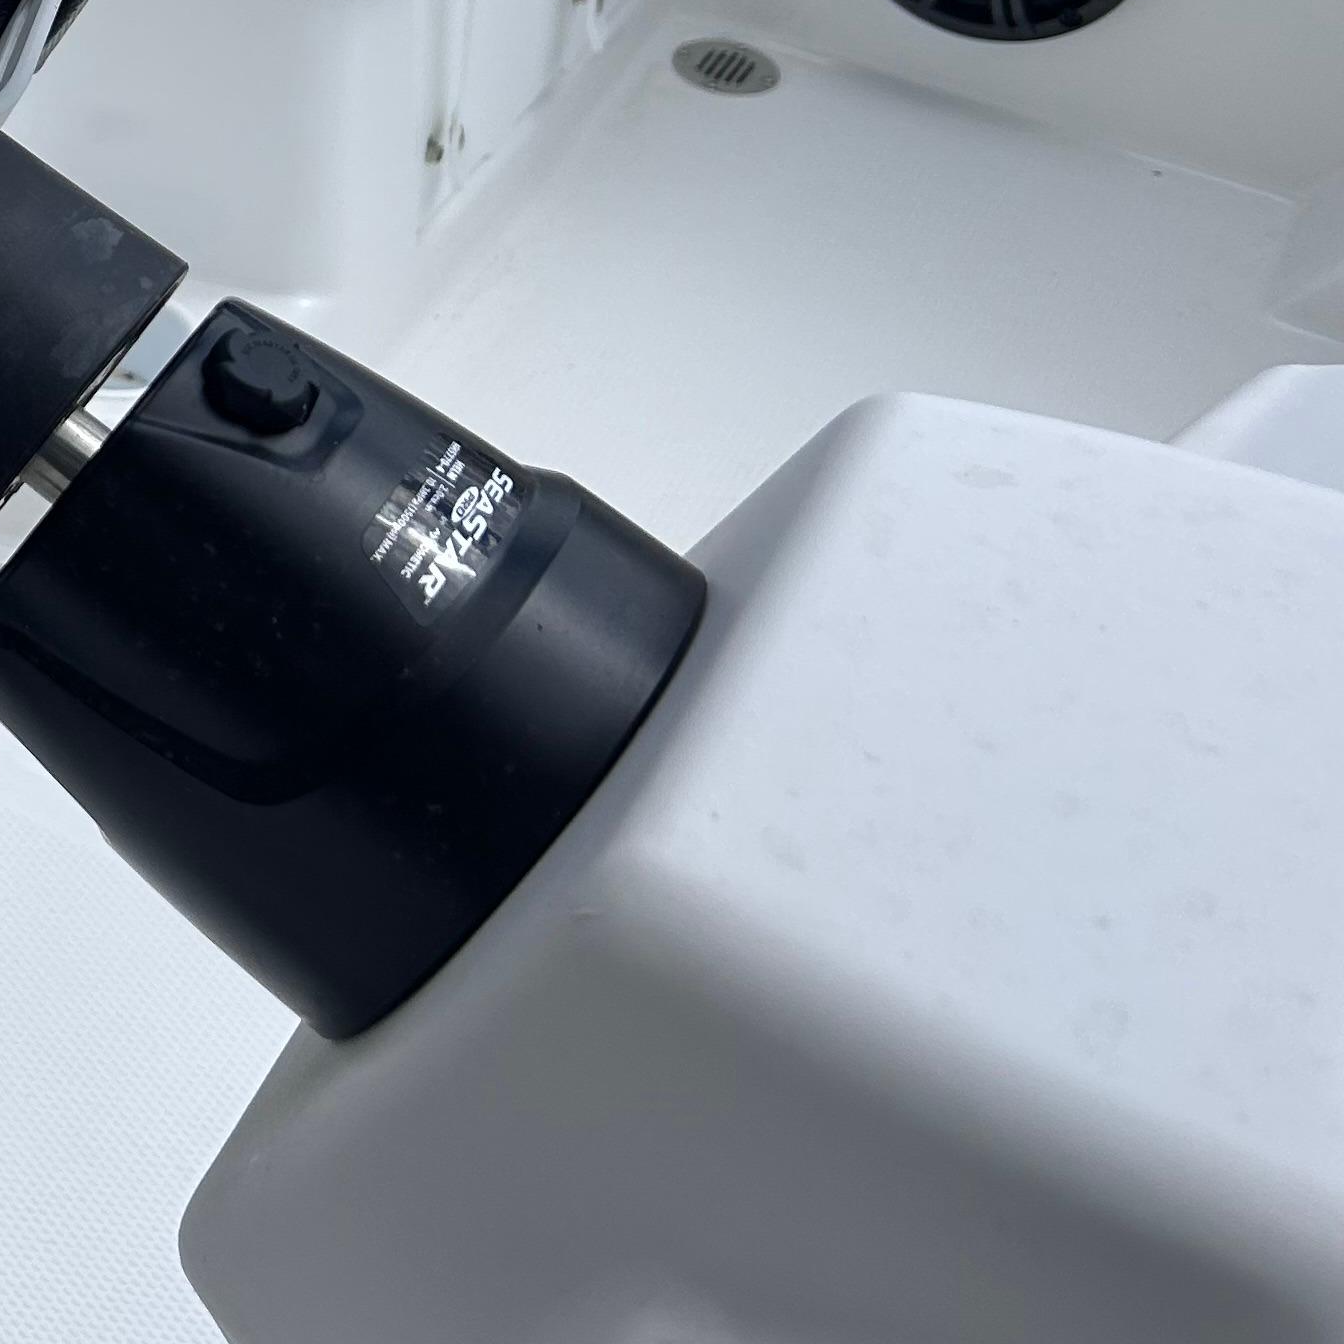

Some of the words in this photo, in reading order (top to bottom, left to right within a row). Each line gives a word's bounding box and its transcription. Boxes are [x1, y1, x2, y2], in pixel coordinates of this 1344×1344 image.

[454, 489, 476, 518] PRO
[417, 466, 515, 599] SEASTAR
[398, 536, 433, 579] OMETIC
